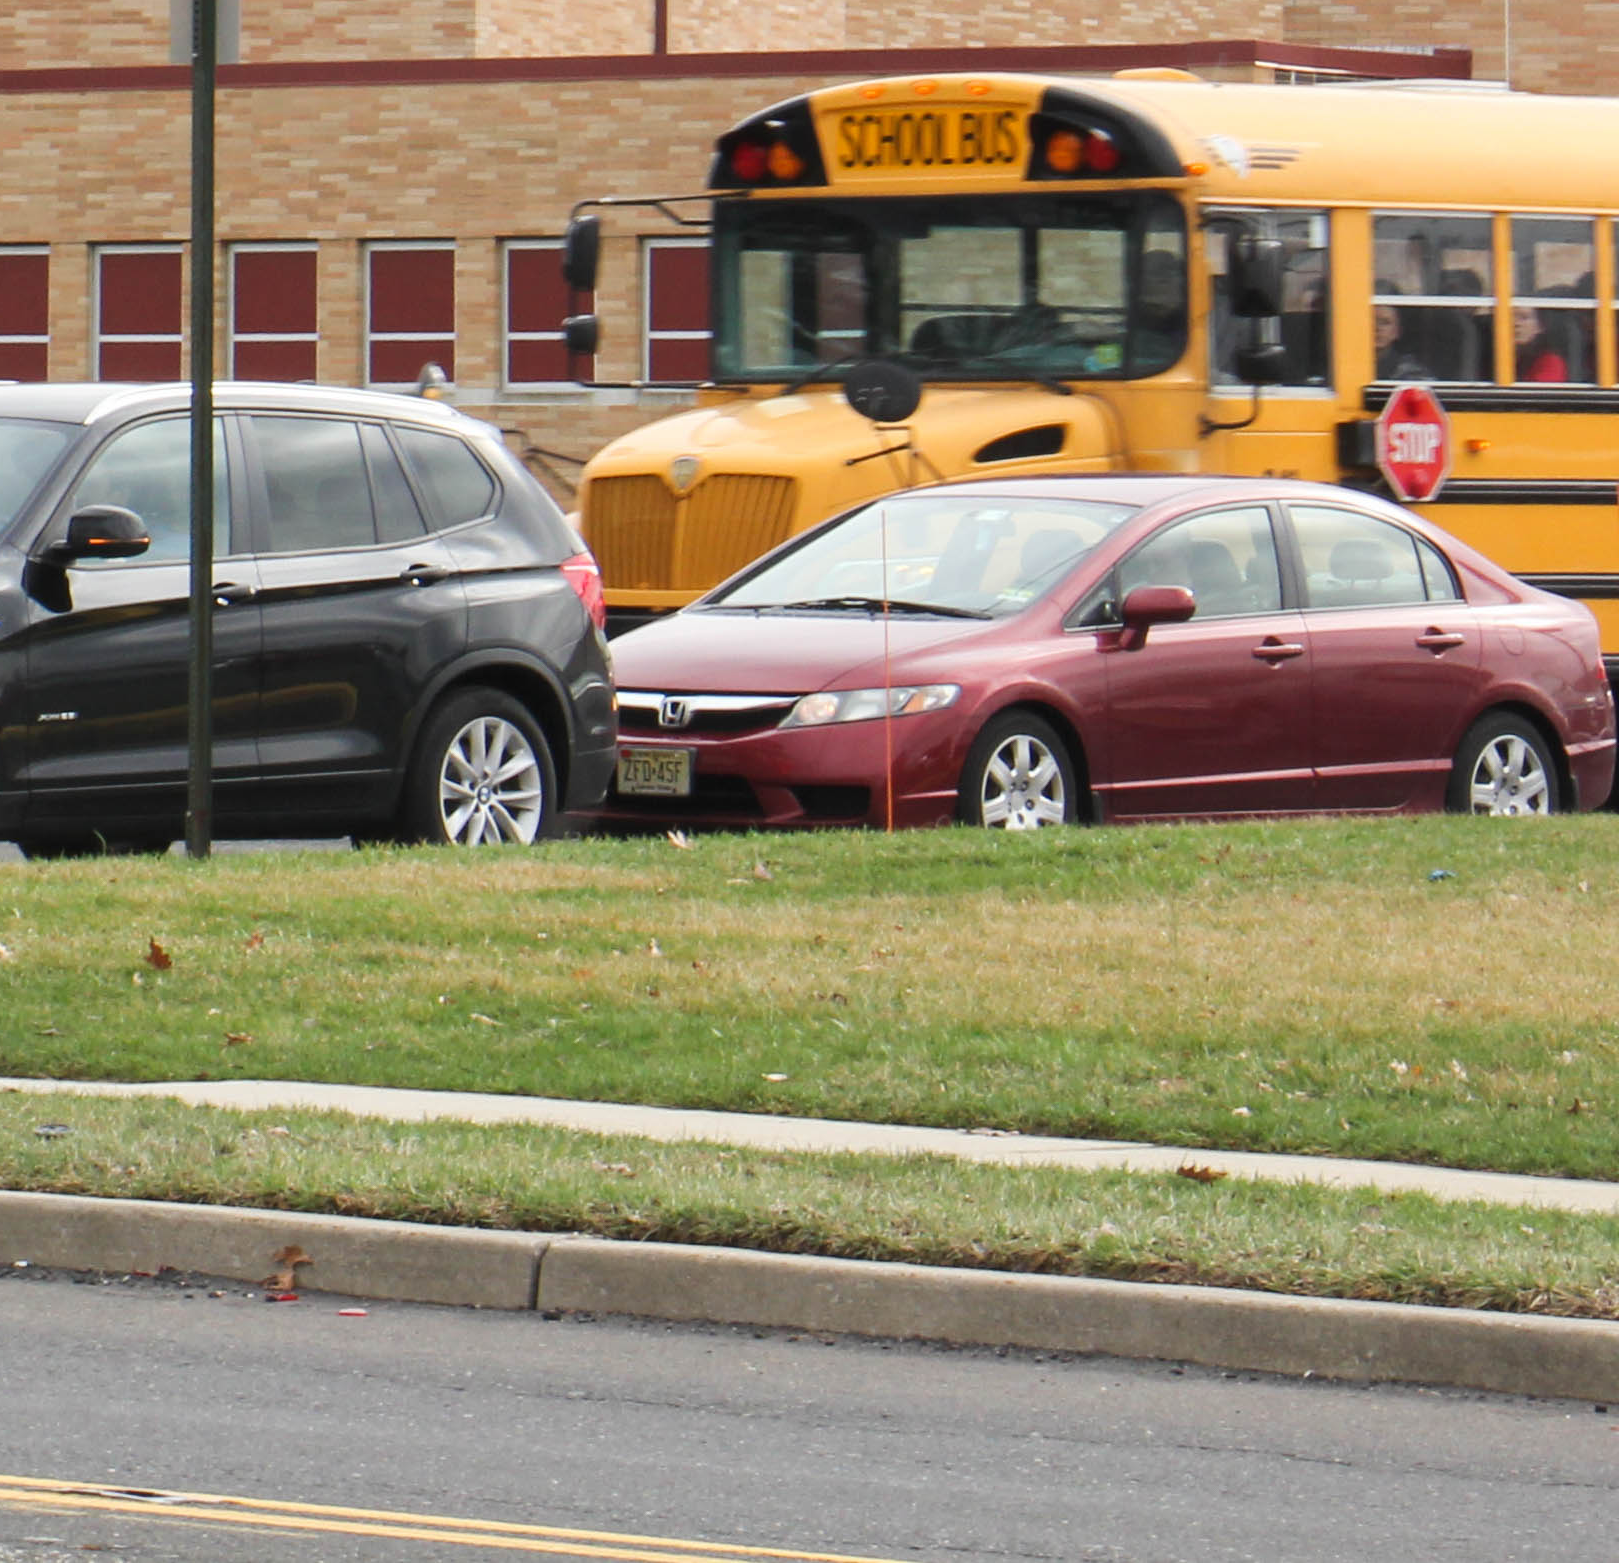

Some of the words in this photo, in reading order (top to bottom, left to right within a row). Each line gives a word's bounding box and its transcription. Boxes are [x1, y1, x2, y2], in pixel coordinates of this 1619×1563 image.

[839, 112, 956, 167] SCHOOL
[960, 110, 1020, 165] BUS
[1388, 422, 1443, 465] STOP
